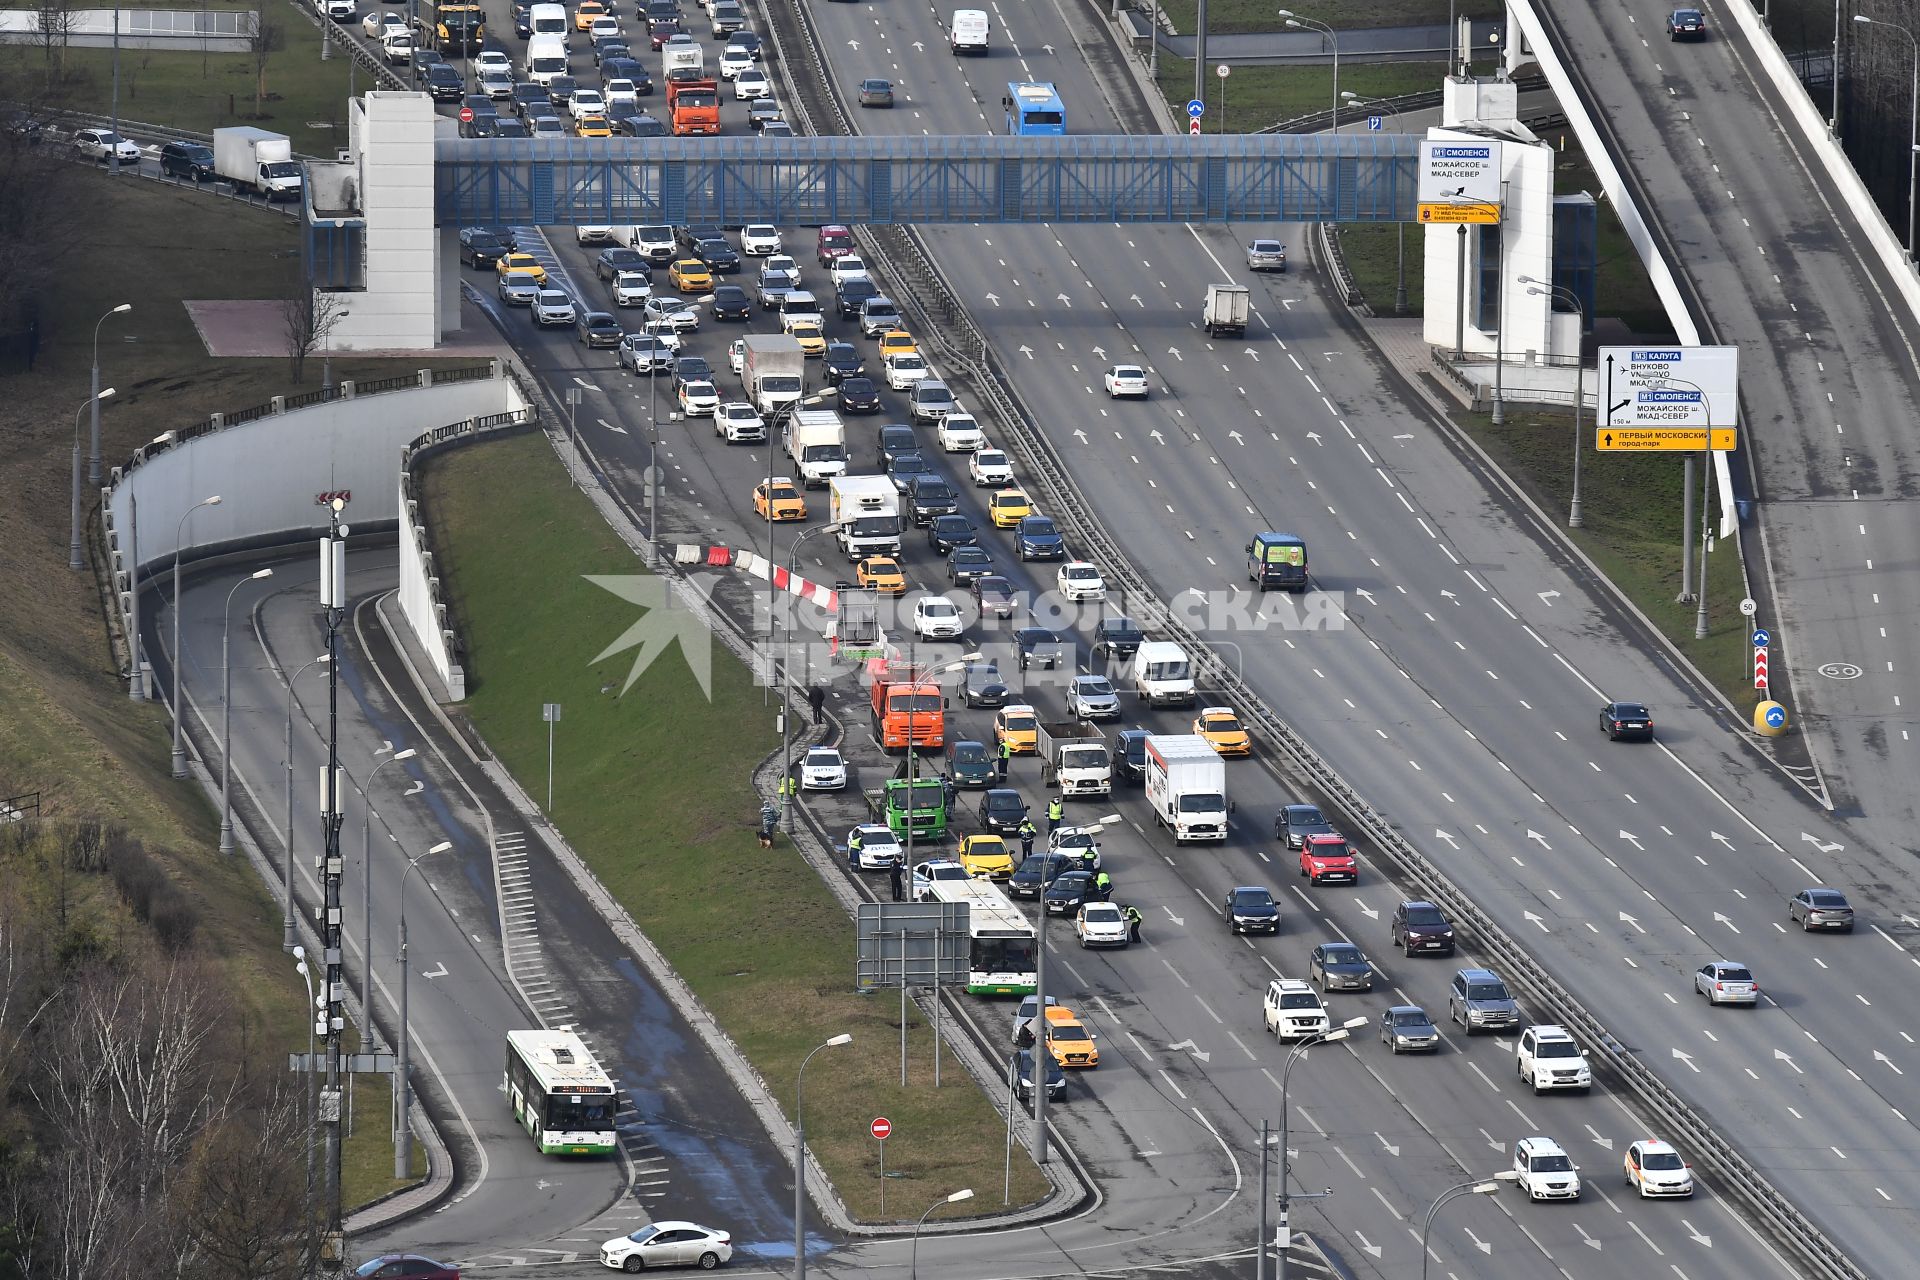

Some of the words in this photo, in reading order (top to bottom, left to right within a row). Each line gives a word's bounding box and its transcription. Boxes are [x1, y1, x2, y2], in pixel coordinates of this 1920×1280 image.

[1434, 149, 1444, 157] М1
[1446, 149, 1489, 157] СМОЛЕНСК
[1743, 603, 1753, 611] 50
[1826, 666, 1856, 676] 50
